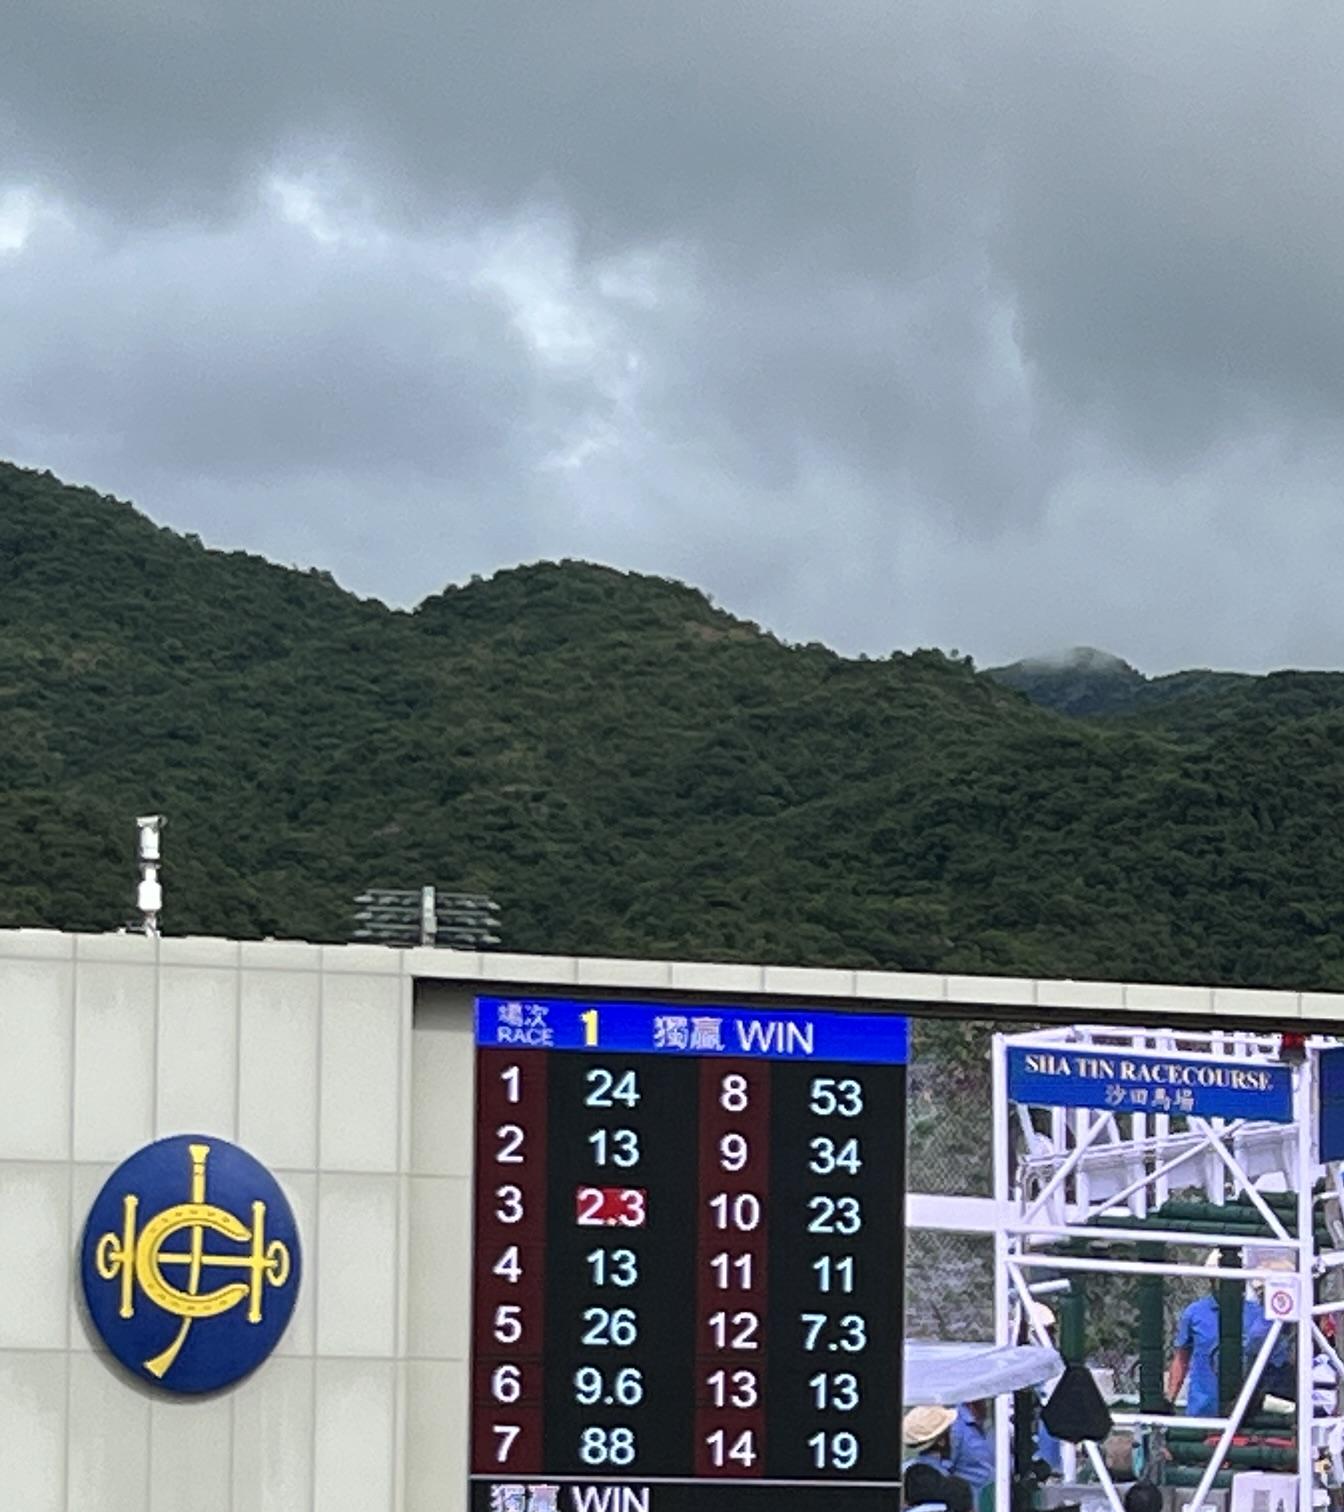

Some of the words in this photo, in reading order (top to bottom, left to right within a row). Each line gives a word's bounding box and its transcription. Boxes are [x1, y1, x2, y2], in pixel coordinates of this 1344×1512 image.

[497, 1027, 554, 1047] RACE
[580, 1008, 599, 1047] 1
[653, 1015, 725, 1051] 獨贏
[735, 1019, 815, 1054] WIN
[502, 1066, 519, 1102] 1
[586, 1070, 640, 1107] 24
[722, 1075, 747, 1111] 8
[811, 1079, 862, 1116] 53
[1075, 1057, 1116, 1079] TIN
[1120, 1060, 1274, 1090] RACECOURSE
[497, 1126, 523, 1162] 2
[589, 1130, 639, 1166] 13
[721, 1134, 747, 1170] 9
[810, 1137, 862, 1174] 34
[497, 1186, 523, 1223] 3
[576, 1189, 645, 1226] 2.3
[710, 1194, 759, 1230] 10
[808, 1197, 861, 1233] 23
[494, 1246, 522, 1282] 4
[587, 1250, 637, 1286] 13
[711, 1253, 751, 1289] 11
[813, 1256, 852, 1292] 11
[495, 1306, 521, 1342] 5
[582, 1308, 636, 1345] 26
[709, 1312, 757, 1348] 12
[802, 1314, 866, 1351] 7.3
[493, 1366, 520, 1402] 6
[576, 1367, 642, 1405] 9.6
[708, 1371, 757, 1407] 13
[810, 1374, 858, 1410] 13
[494, 1426, 520, 1461] 7
[581, 1428, 635, 1464] 88
[707, 1430, 756, 1466] 14
[809, 1432, 857, 1468] 19
